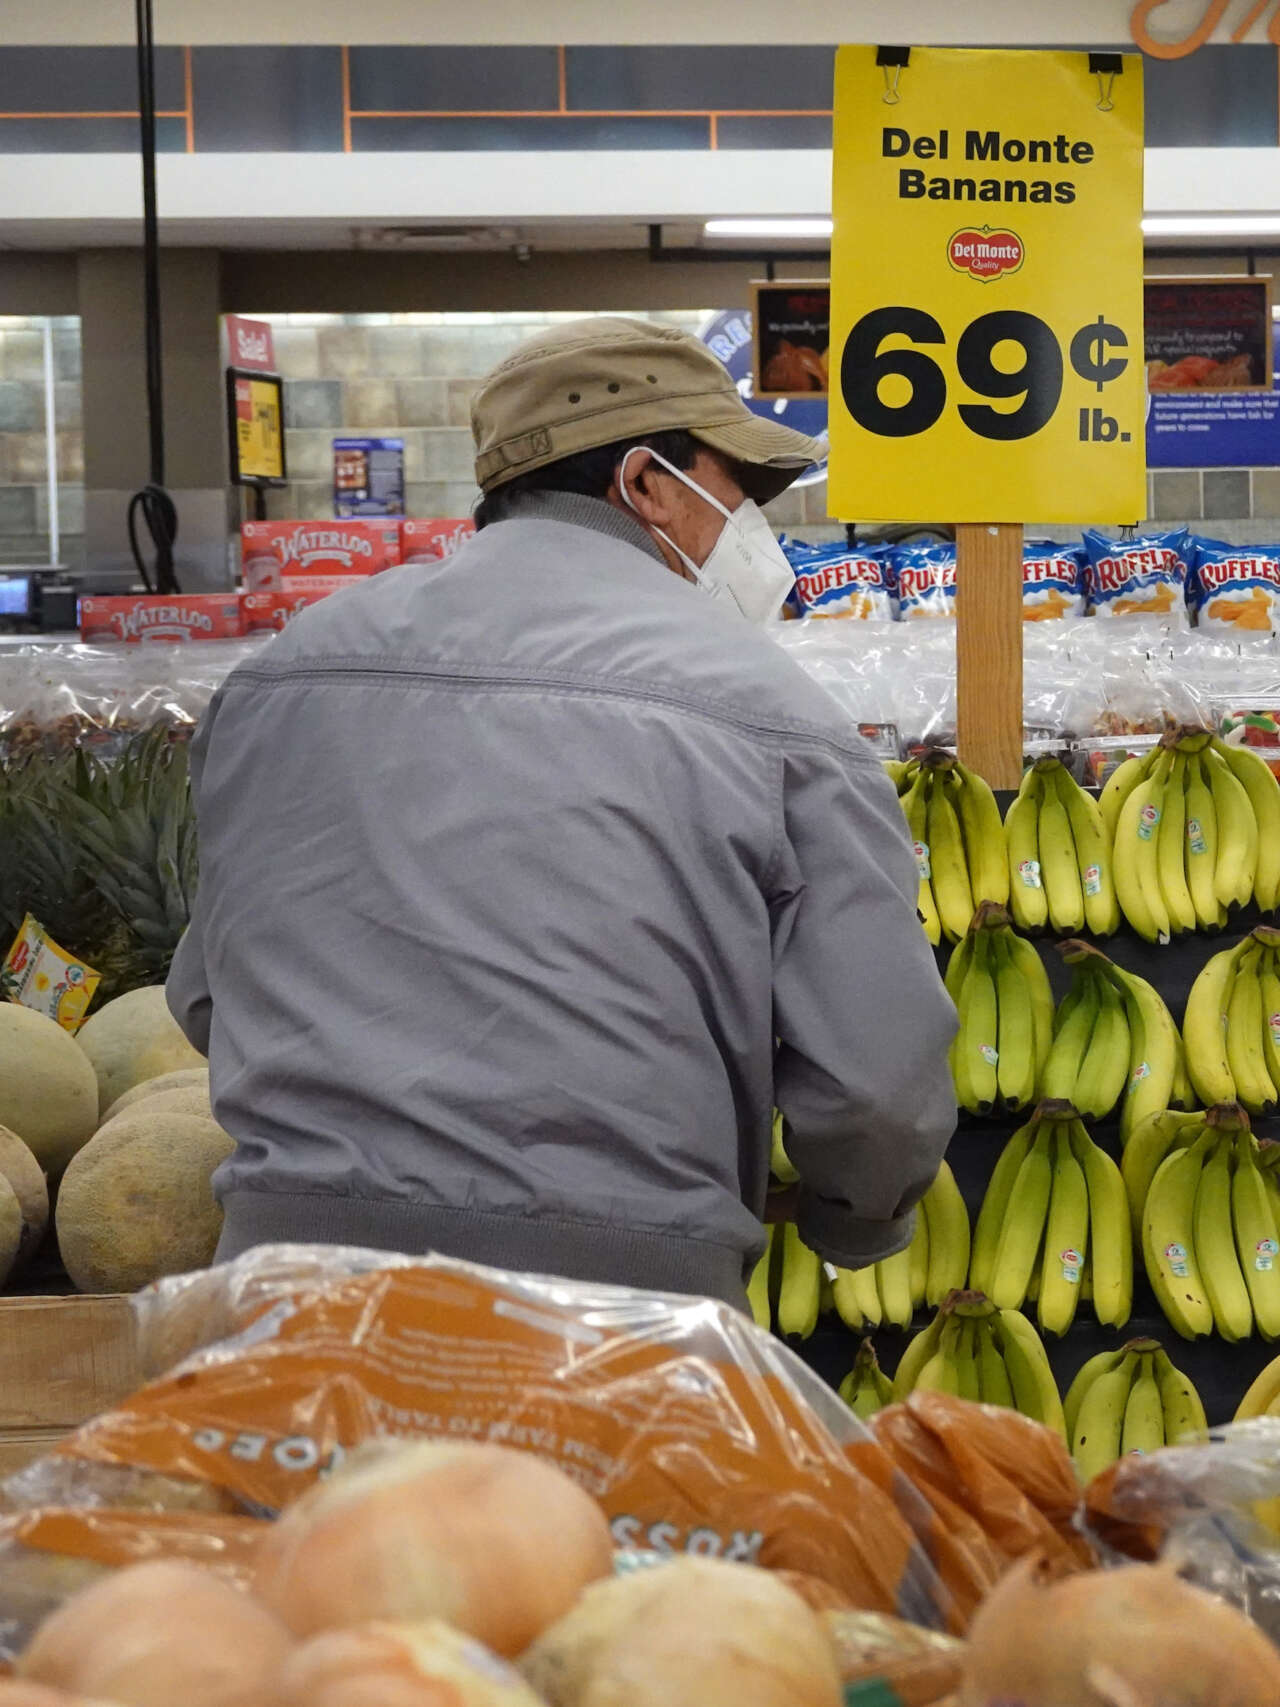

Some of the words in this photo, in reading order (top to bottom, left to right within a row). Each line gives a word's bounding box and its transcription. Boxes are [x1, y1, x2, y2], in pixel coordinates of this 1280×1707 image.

[882, 128, 948, 160] Del
[965, 131, 1094, 163] Monte
[899, 169, 1076, 204] Bananas
[954, 243, 975, 257] Del
[977, 244, 1019, 259] Monte
[1079, 408, 1131, 442] lb.
[272, 526, 372, 568] WATERLOO
[796, 560, 882, 603] RUFFLES
[1023, 560, 1076, 584] FFLES
[1099, 548, 1180, 592] RUFFLES
[111, 603, 212, 640] WATERLOO
